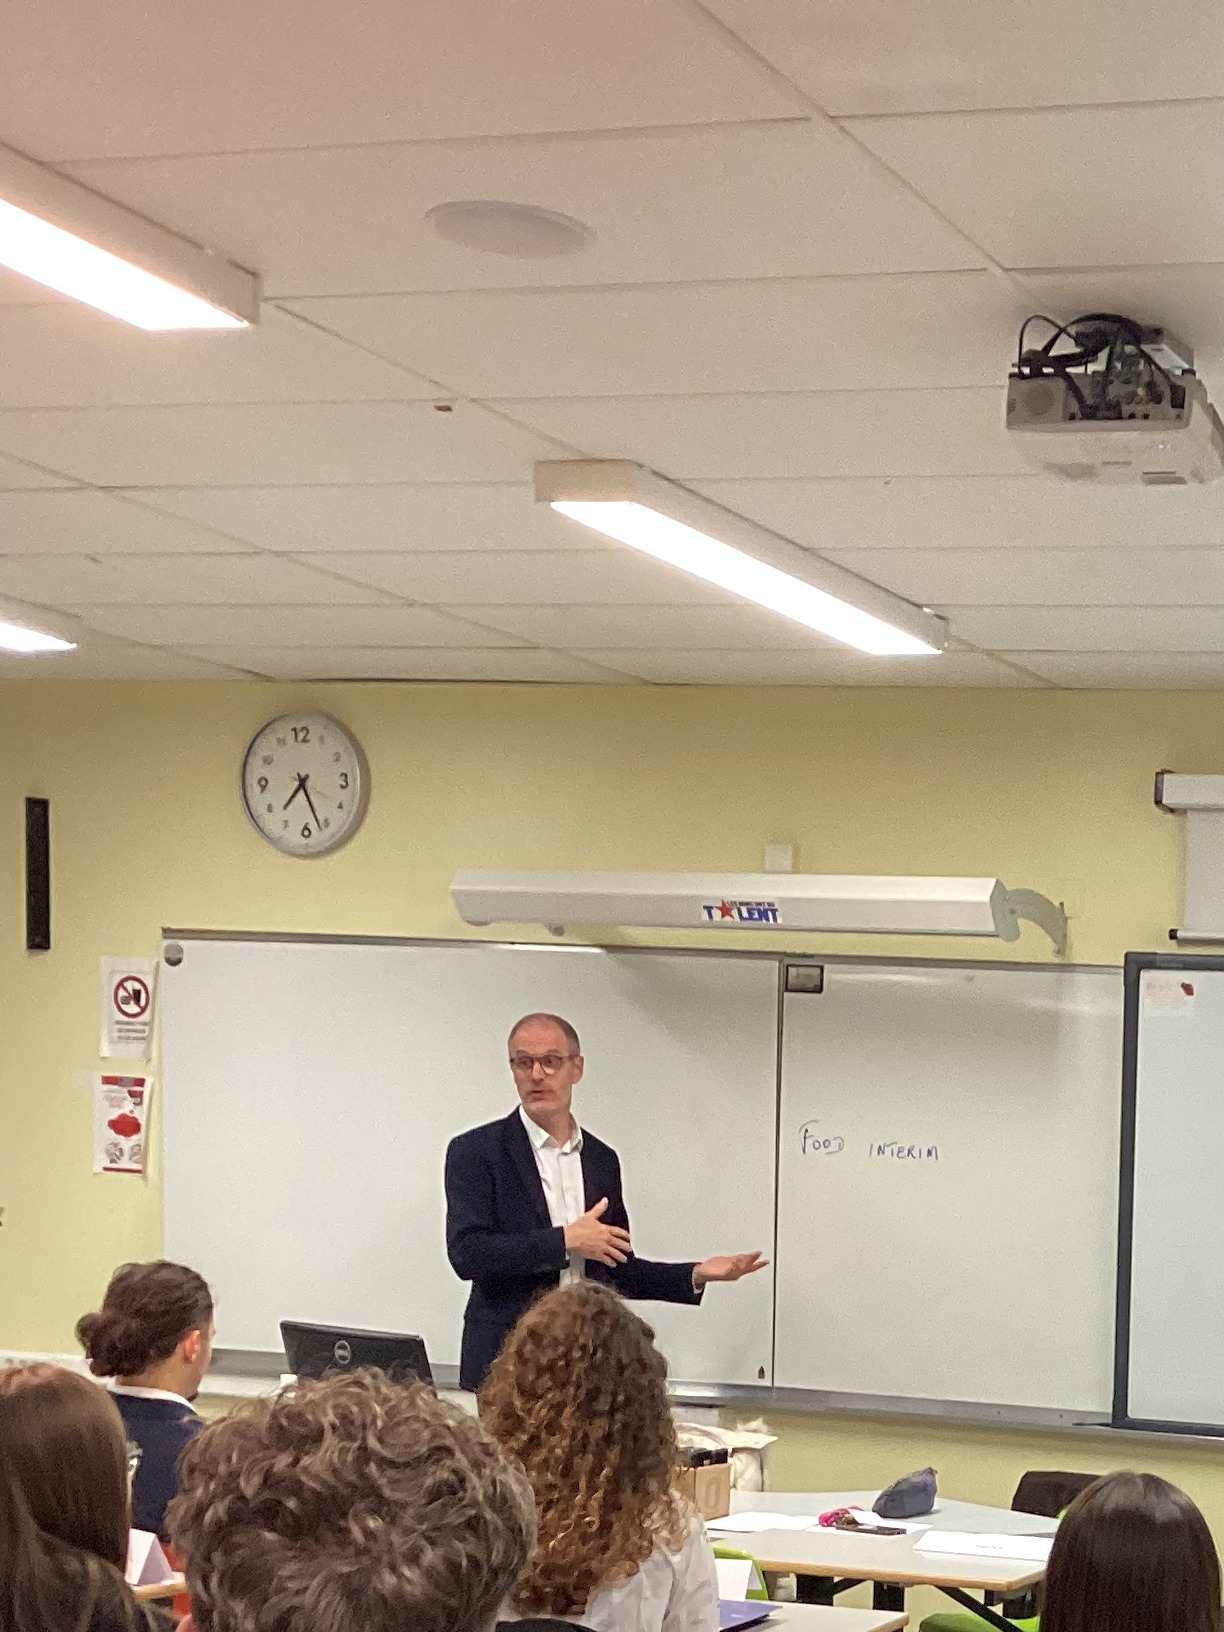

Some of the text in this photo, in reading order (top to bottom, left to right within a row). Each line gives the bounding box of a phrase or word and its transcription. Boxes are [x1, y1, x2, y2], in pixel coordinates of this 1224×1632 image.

[291, 726, 310, 743] 12
[257, 776, 269, 794] 9
[339, 772, 349, 789] 3
[301, 822, 312, 839] 6
[869, 1141, 938, 1161] INTERIM
